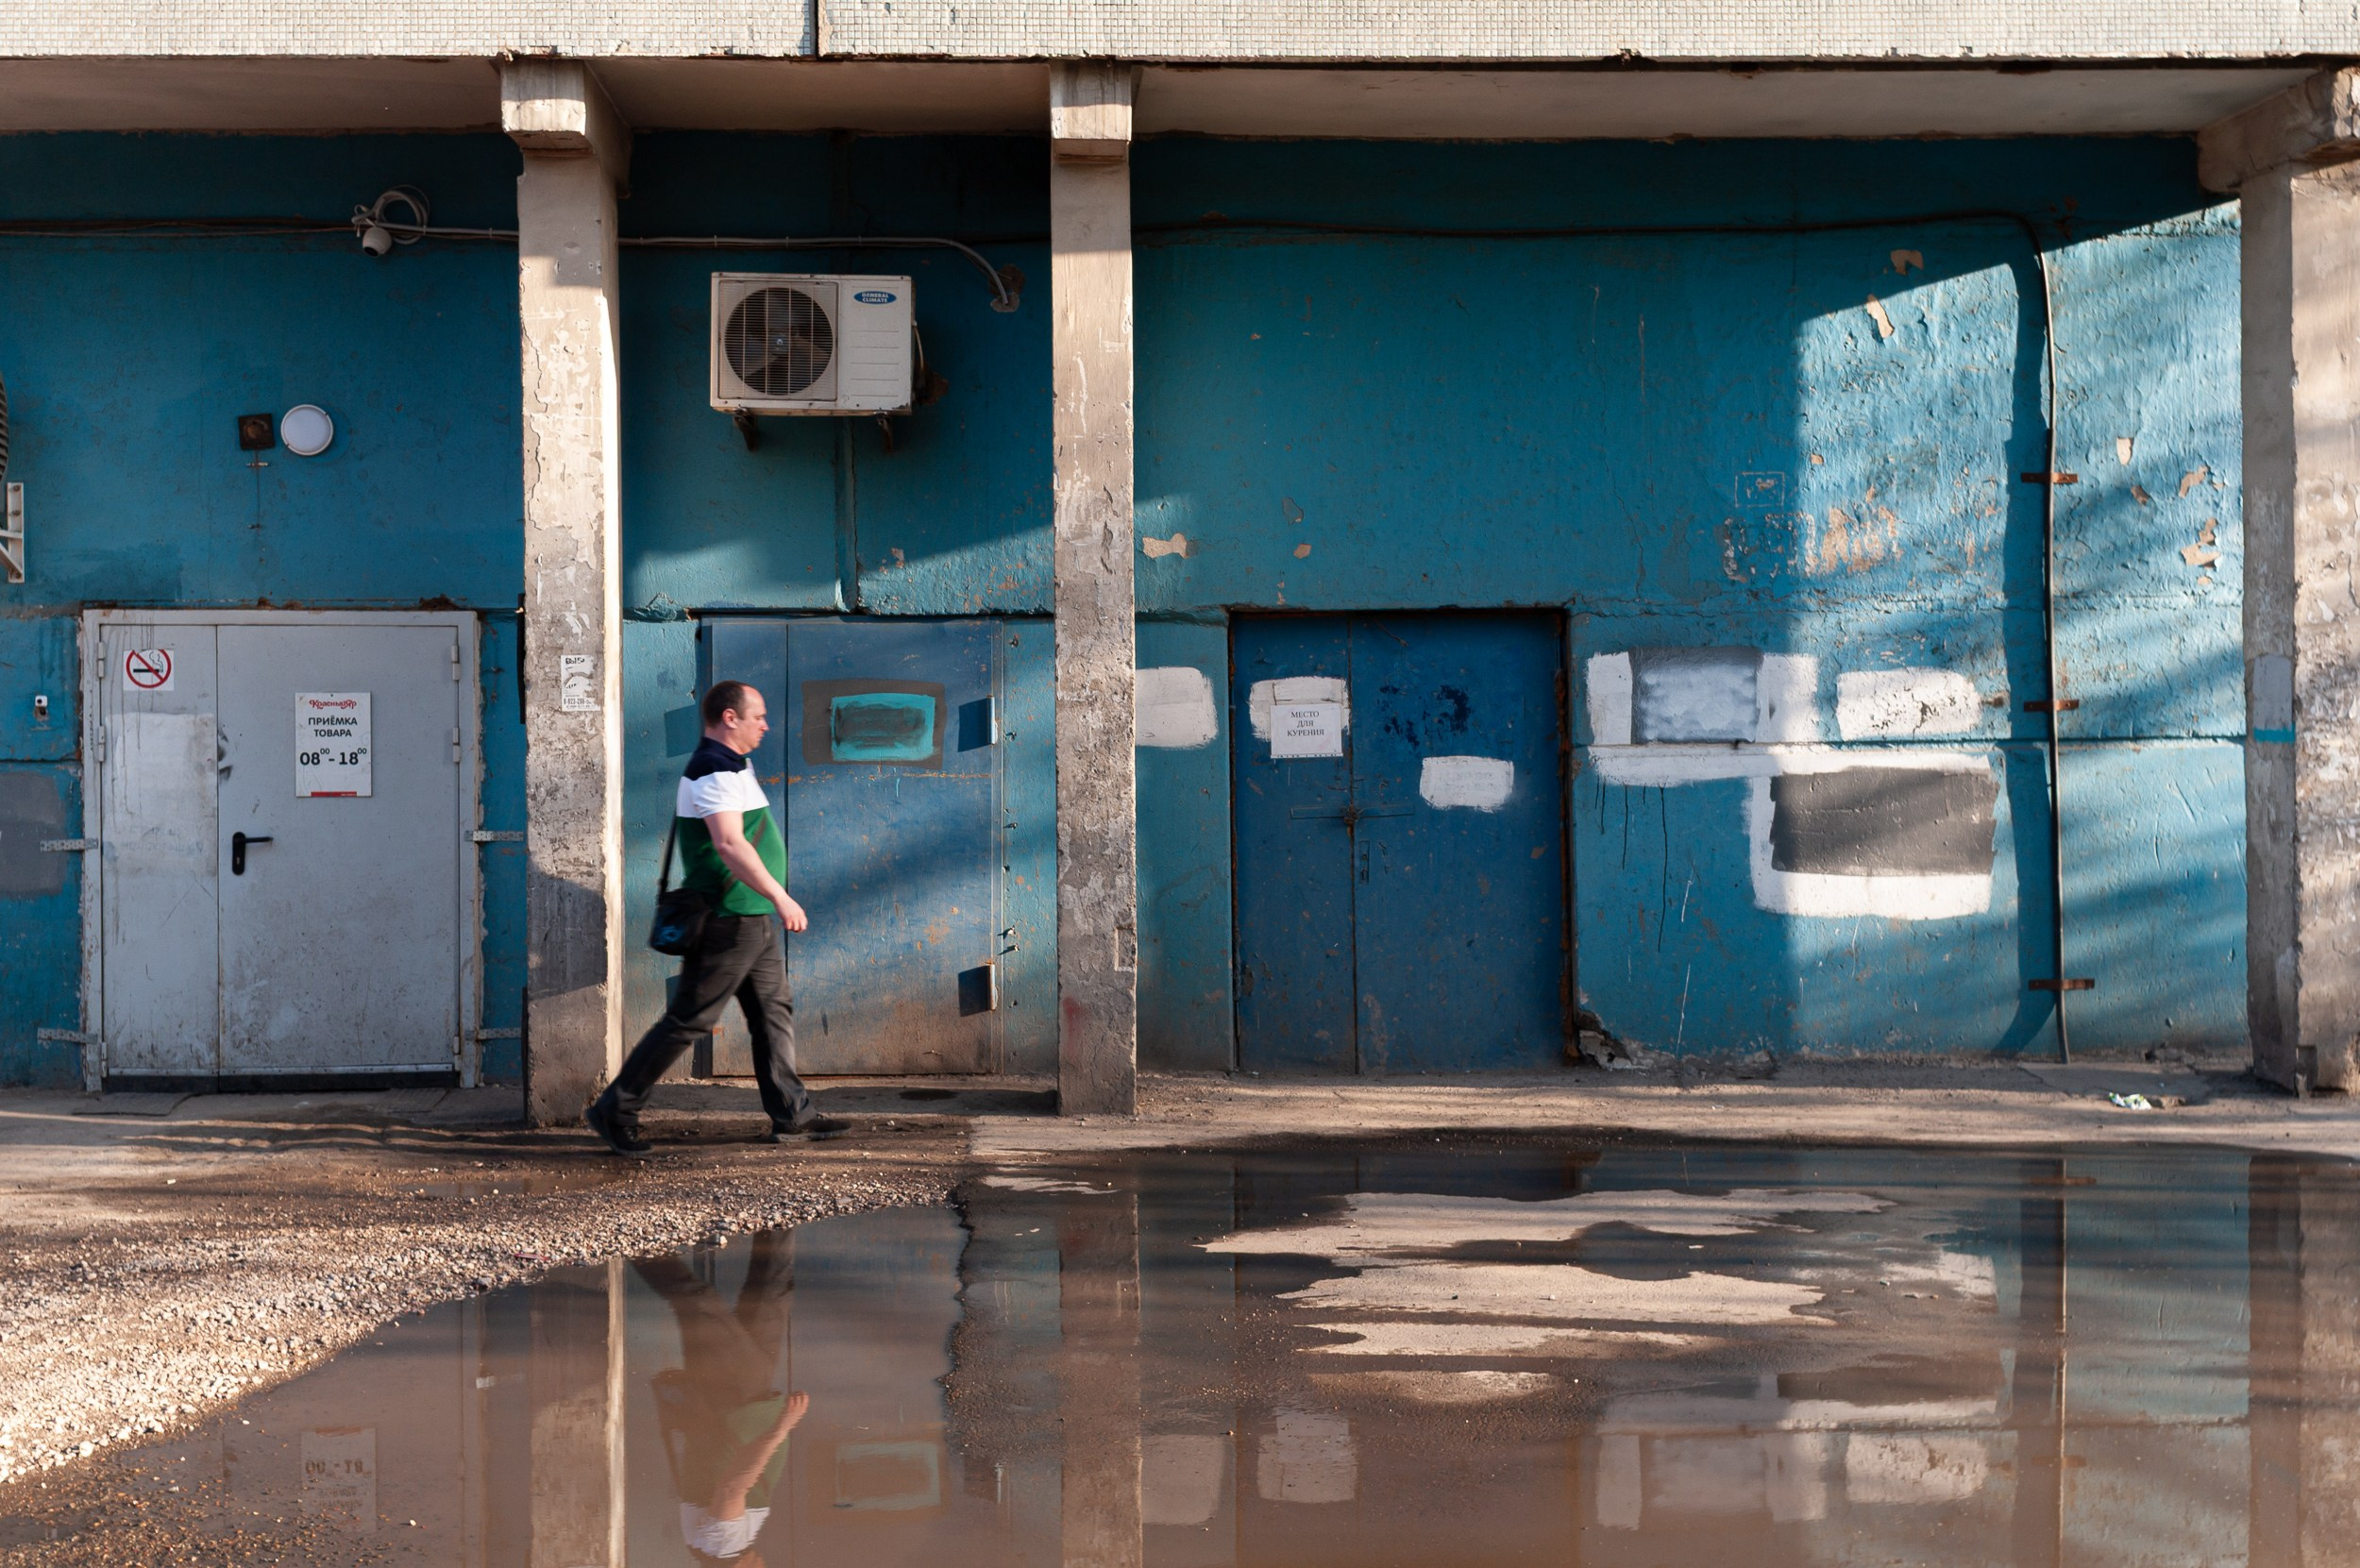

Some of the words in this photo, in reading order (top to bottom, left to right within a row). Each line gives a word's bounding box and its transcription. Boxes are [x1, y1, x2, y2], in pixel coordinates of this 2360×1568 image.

[308, 715, 358, 726] ПРИЁМКА
[314, 729, 352, 737] ТОВАРА
[1287, 729, 1324, 737] КУРЕНИЯ
